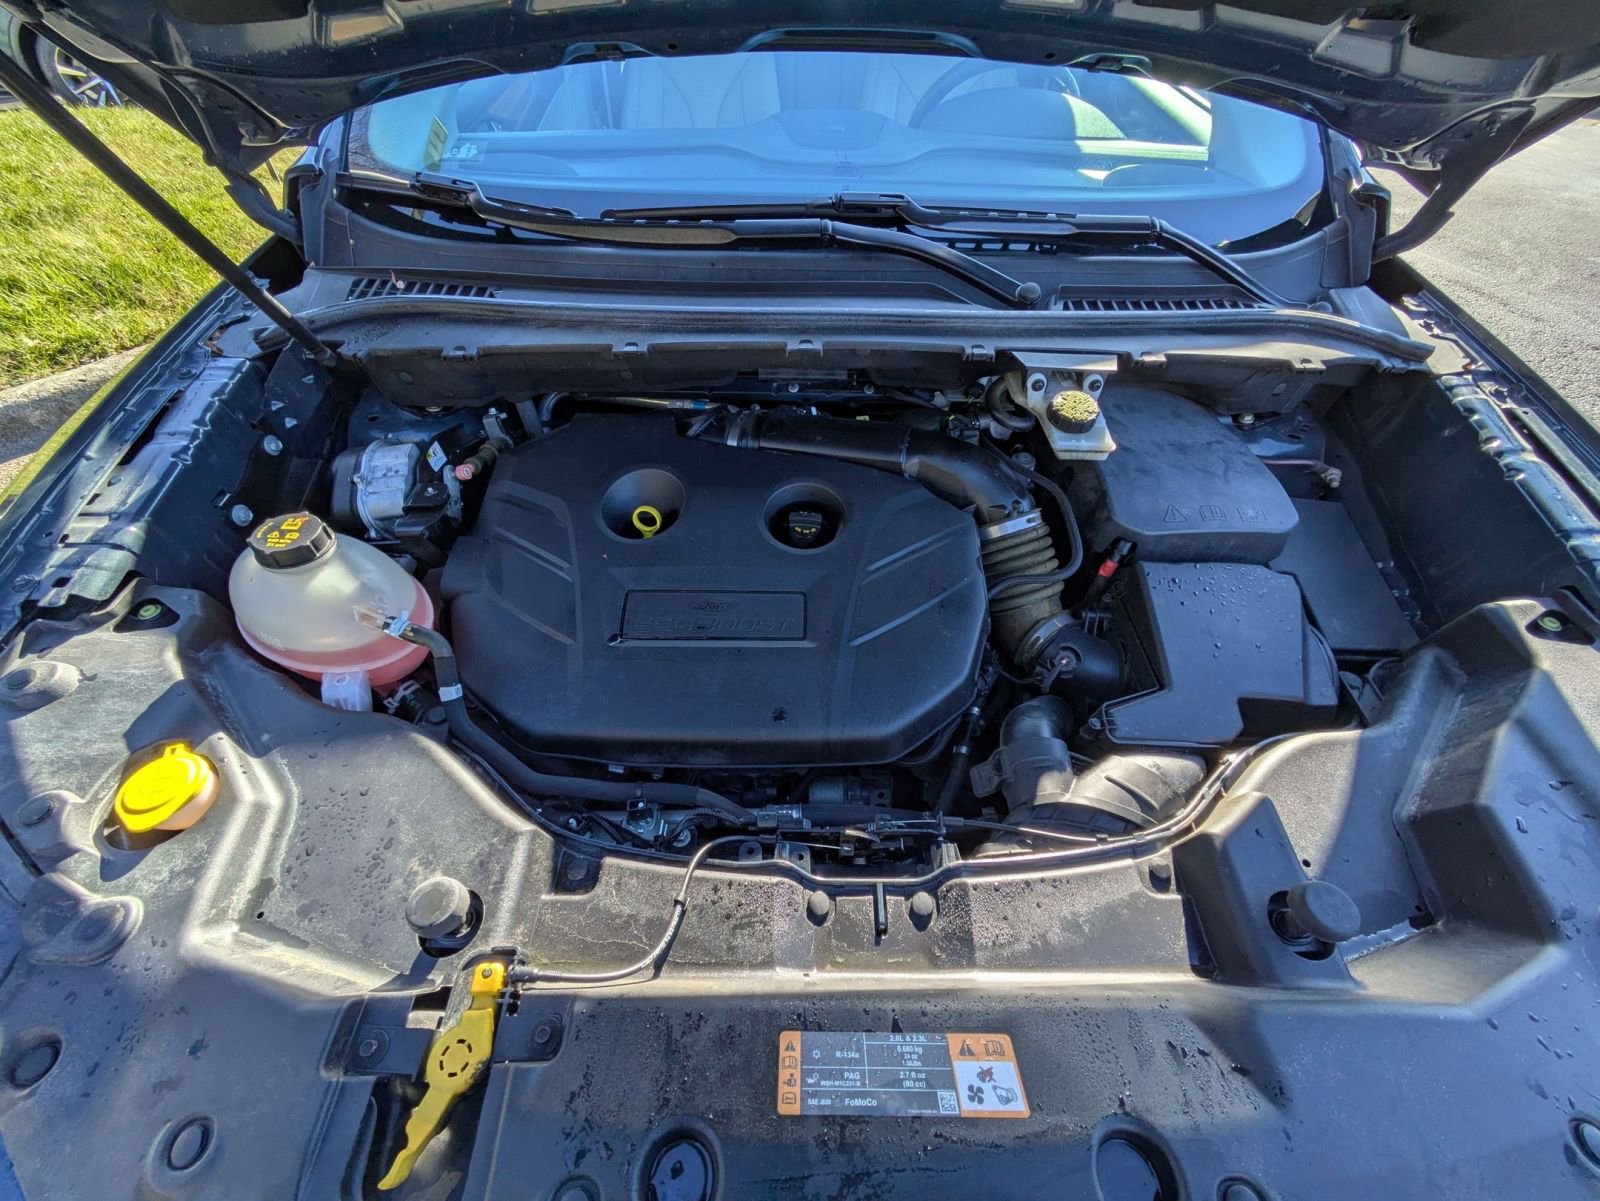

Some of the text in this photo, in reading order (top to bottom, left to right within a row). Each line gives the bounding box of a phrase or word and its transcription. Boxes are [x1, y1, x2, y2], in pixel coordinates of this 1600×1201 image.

[912, 1035, 928, 1043] 2.3L
[914, 1045, 923, 1054] kg
[835, 1051, 860, 1059] R-134a
[844, 1072, 861, 1080] PAG
[899, 1071, 909, 1079] 2.7
[903, 1080, 926, 1089] (80 cc)
[844, 1098, 878, 1106] FoMoCo
